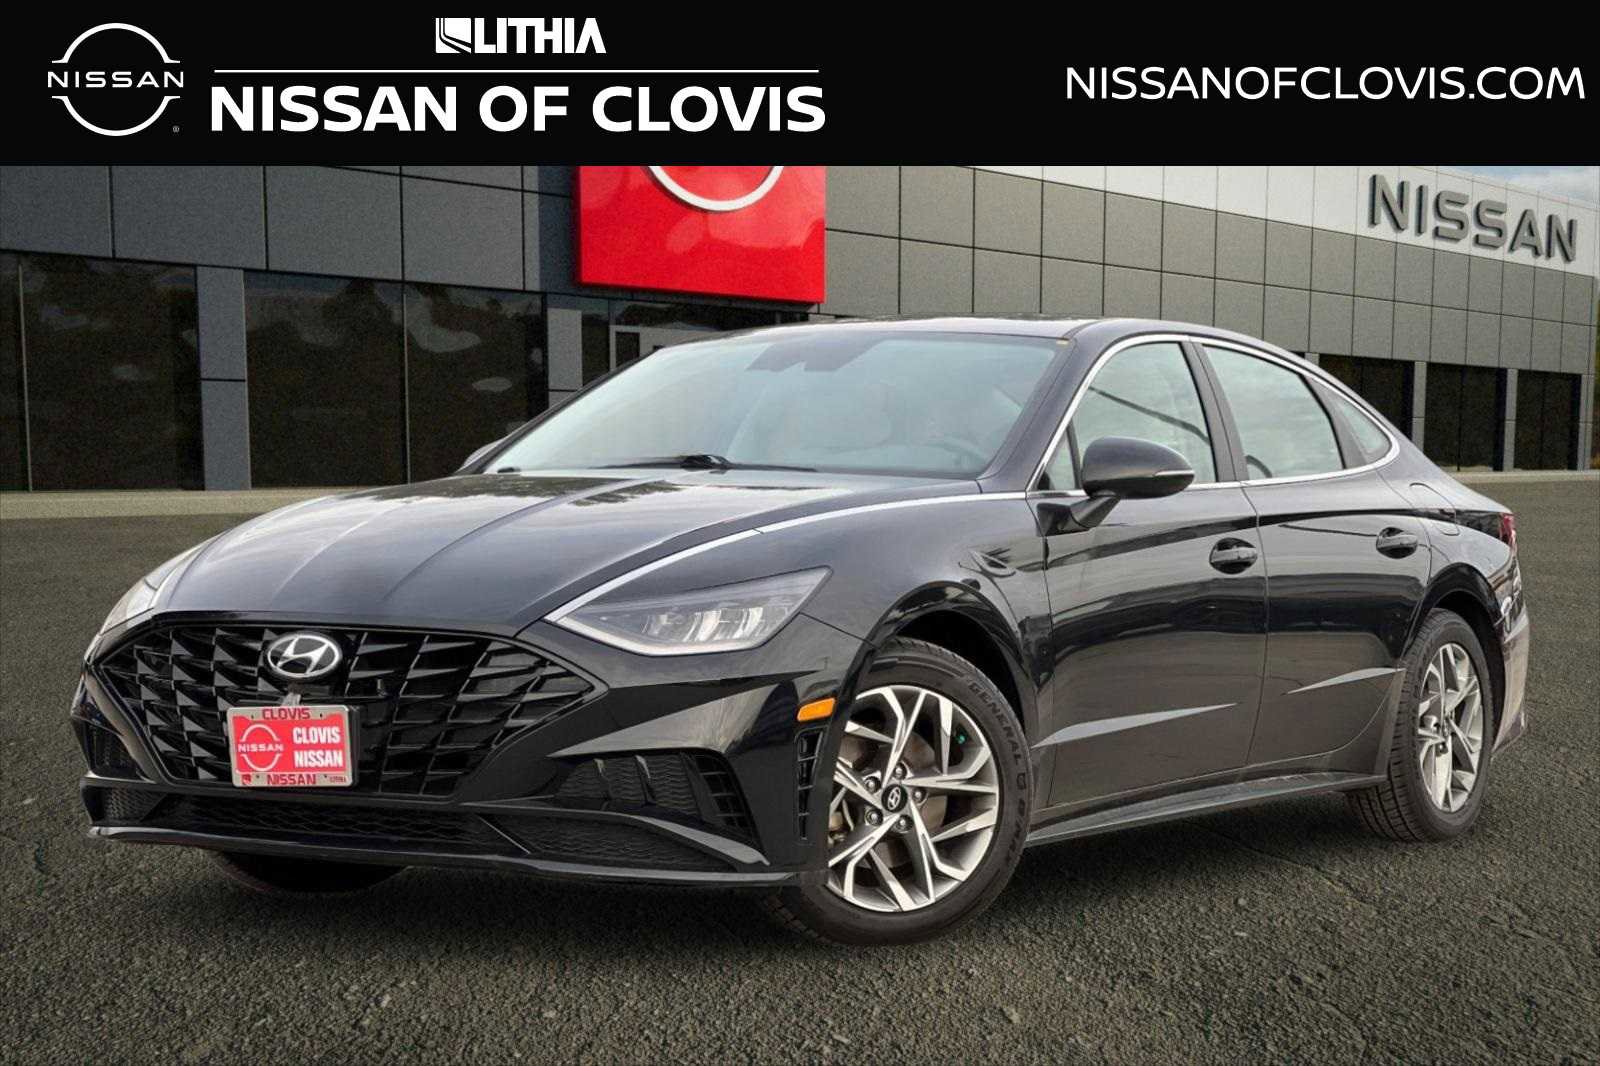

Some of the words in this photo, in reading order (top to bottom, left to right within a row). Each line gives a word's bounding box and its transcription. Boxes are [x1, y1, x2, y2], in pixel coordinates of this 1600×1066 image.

[1368, 174, 1577, 263] NISSAN
[262, 708, 311, 720] CLOVIS
[292, 727, 340, 744] CLOVIS
[238, 743, 284, 752] NISSAN
[294, 750, 343, 768] NISSAN
[266, 774, 316, 785] NISSAN
